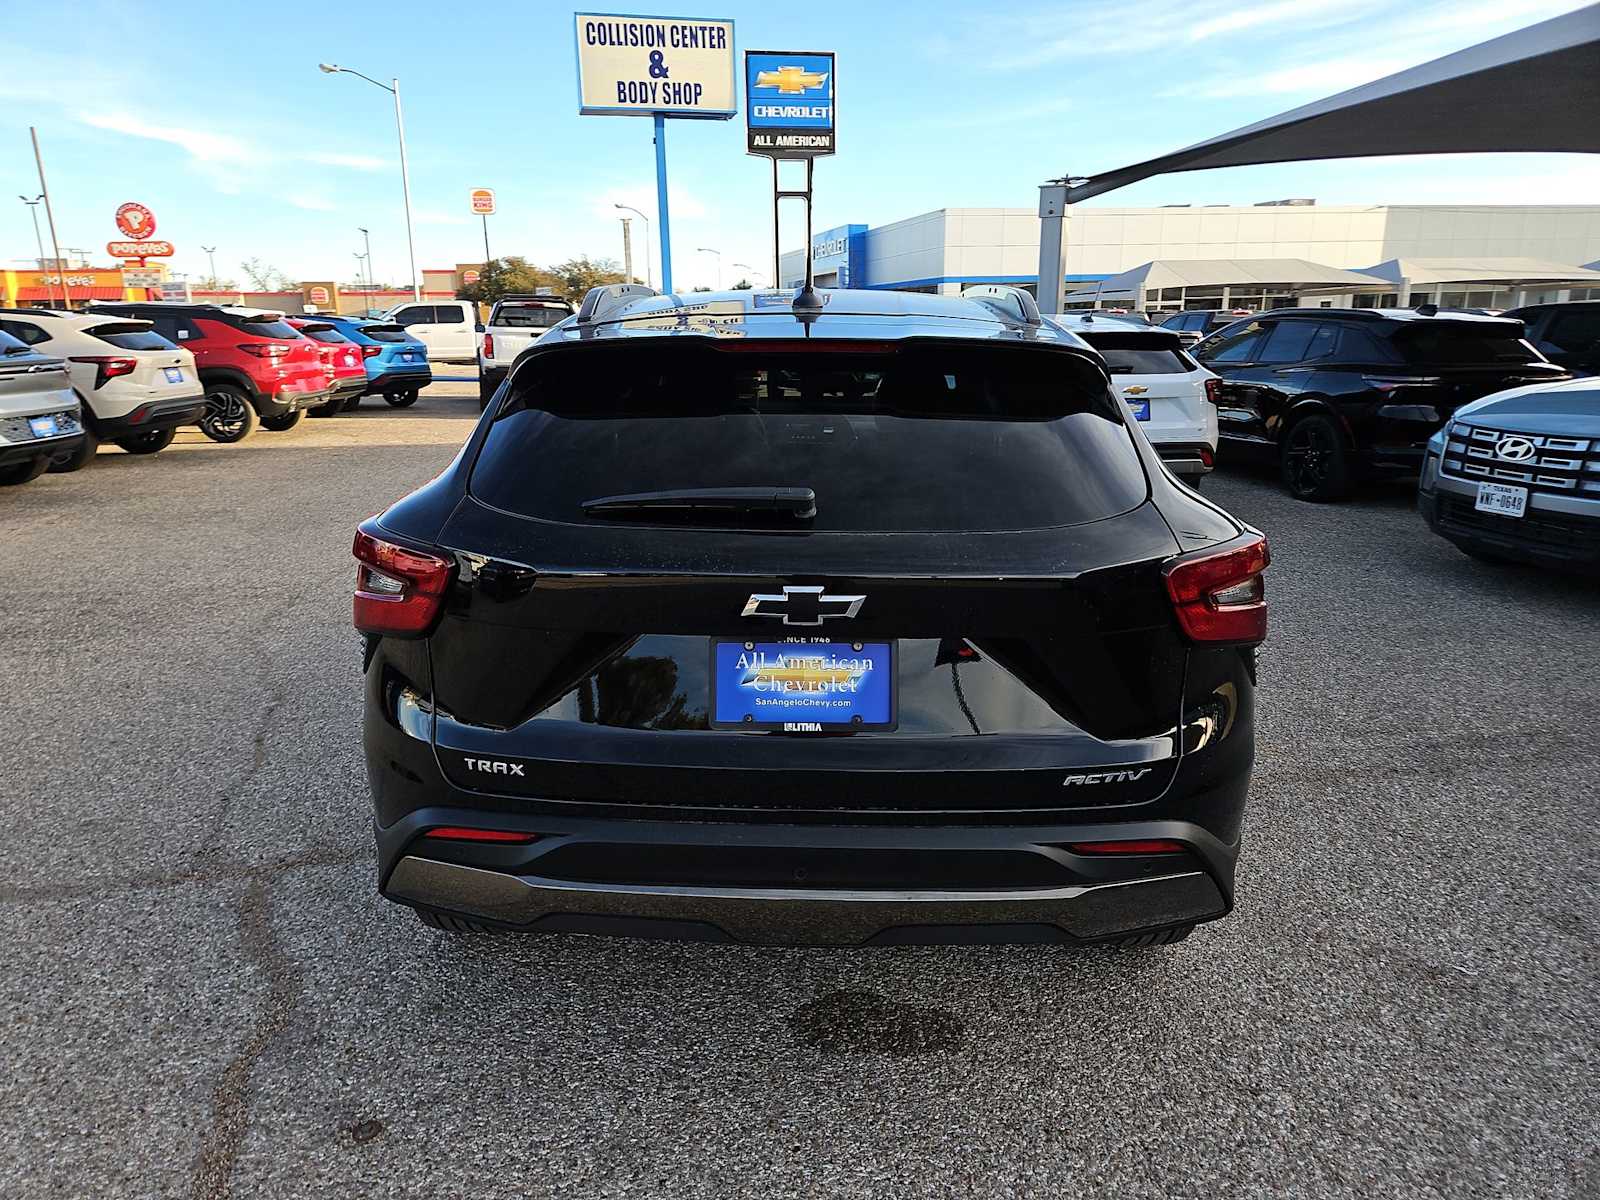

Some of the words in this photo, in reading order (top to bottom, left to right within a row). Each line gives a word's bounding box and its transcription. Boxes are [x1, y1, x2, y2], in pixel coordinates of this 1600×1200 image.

[586, 21, 666, 47] COLLISION
[670, 25, 727, 49] CENTER
[648, 50, 669, 79] &
[617, 80, 657, 104] BODY
[663, 83, 703, 105] SHOP
[753, 105, 830, 119] CHEVROLET
[753, 135, 774, 147] ALL
[775, 135, 830, 147] AMERICAN
[735, 652, 765, 670] All
[775, 653, 874, 671] American
[753, 675, 859, 693] Chevrolet
[755, 697, 851, 709] SanAngeloChevy.com
[792, 722, 823, 732] LITHIA
[464, 758, 525, 777] TRAX
[1063, 768, 1153, 786] ACTIV
